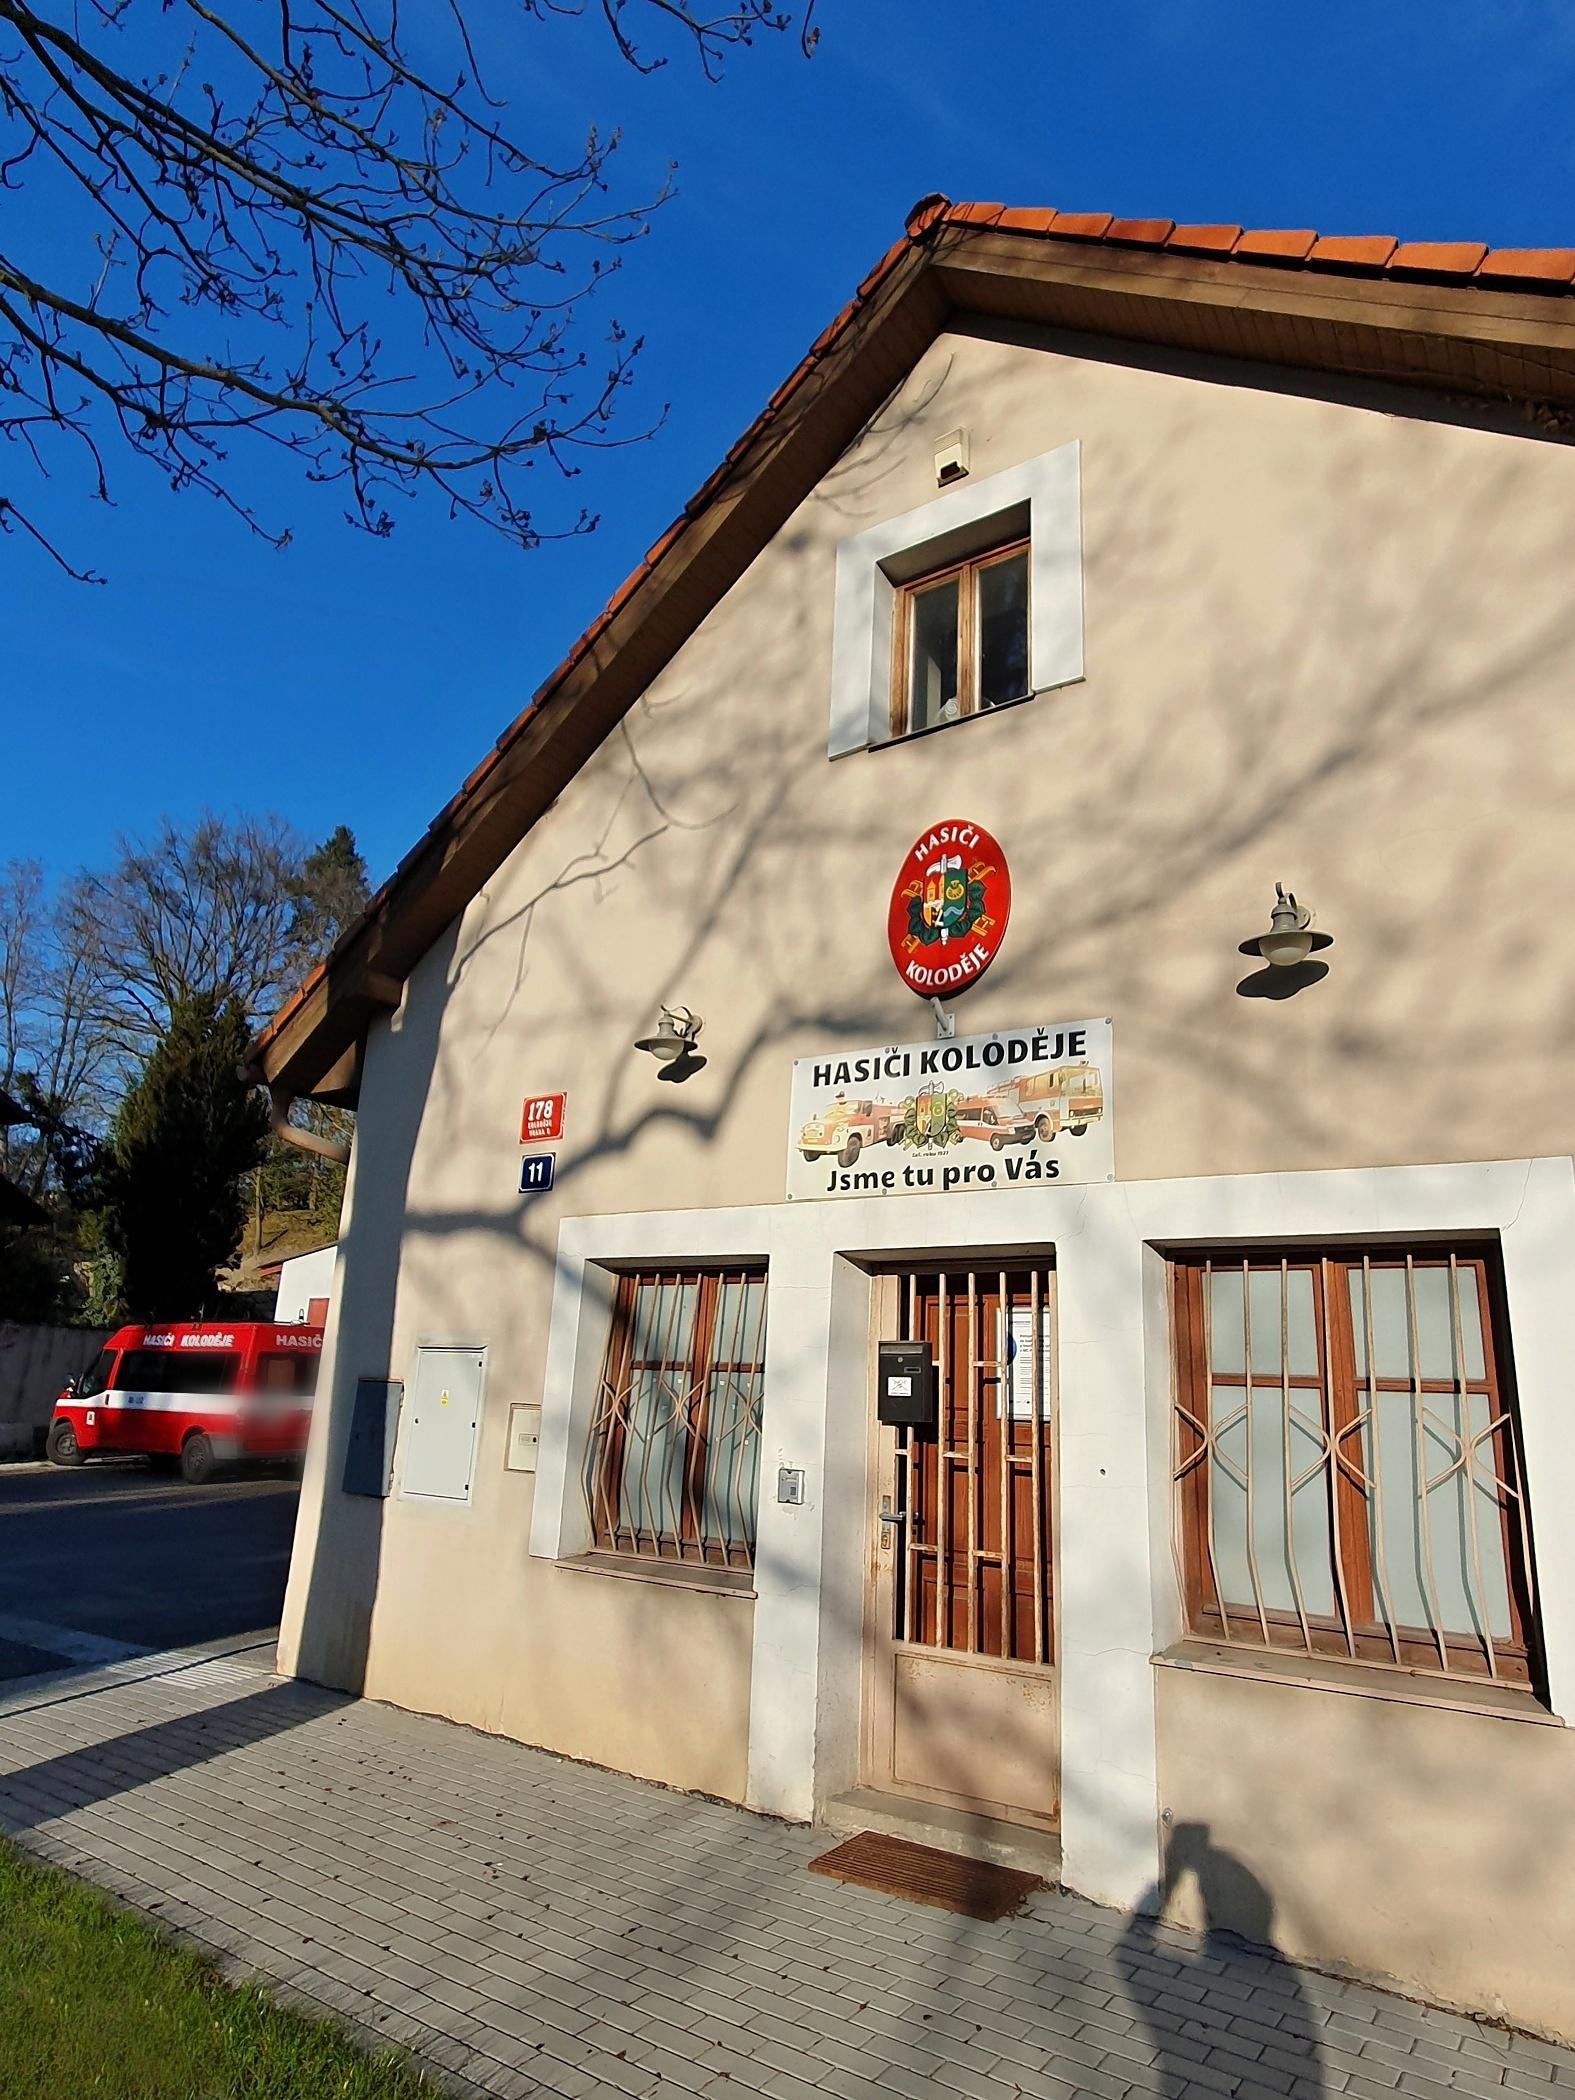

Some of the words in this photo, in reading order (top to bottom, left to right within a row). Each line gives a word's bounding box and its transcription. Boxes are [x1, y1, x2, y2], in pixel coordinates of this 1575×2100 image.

[914, 824, 980, 862] HASIČI
[905, 943, 990, 986] KOLODĚJE
[812, 1046, 911, 1088] HASIČI
[920, 1027, 1087, 1074] KOLODĚJE
[528, 1099, 554, 1121] 178
[528, 1161, 544, 1183] 11
[827, 1168, 896, 1192] Jsme
[902, 1164, 934, 1186] tu
[942, 1162, 996, 1191] pro
[1004, 1149, 1060, 1180] Vás
[143, 1332, 175, 1347] HASIČI
[180, 1331, 235, 1348] KOLODĚJE
